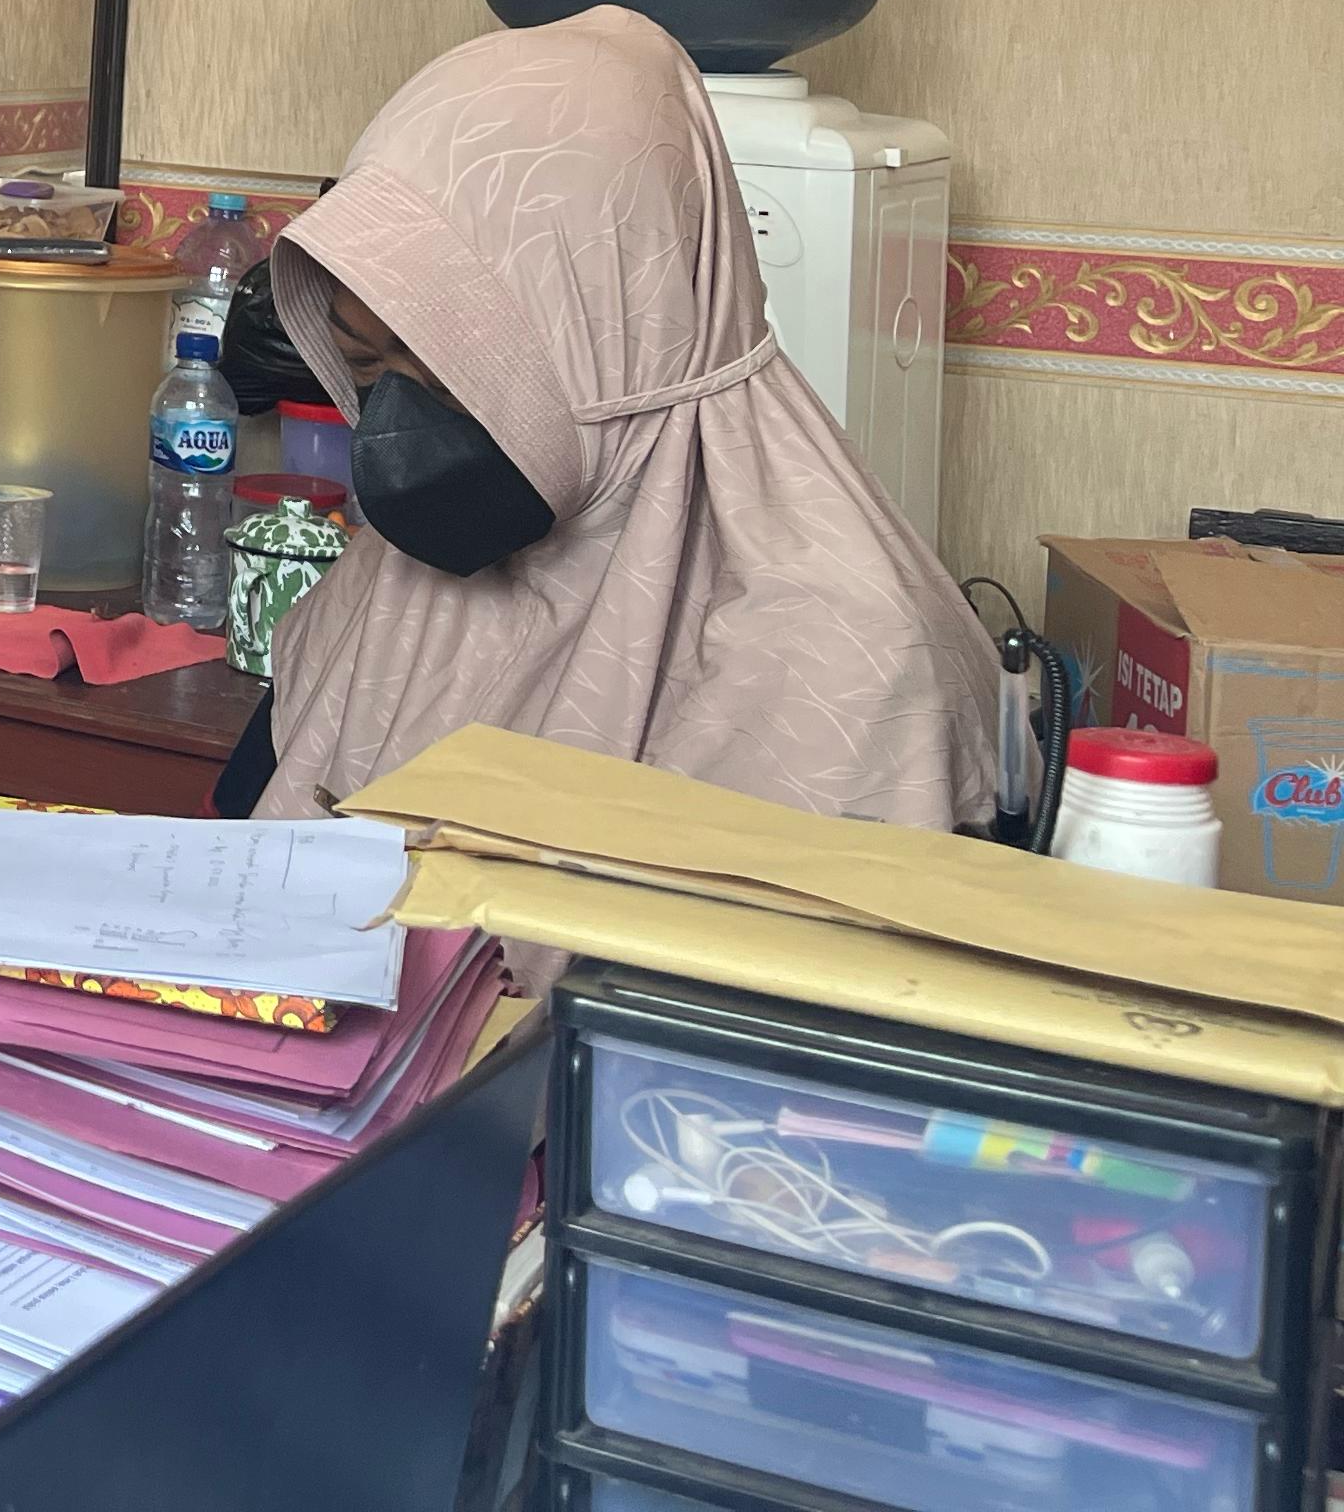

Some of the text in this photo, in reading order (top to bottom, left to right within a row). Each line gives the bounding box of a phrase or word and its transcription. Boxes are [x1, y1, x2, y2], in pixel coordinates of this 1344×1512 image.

[177, 429, 230, 452] AQUA
[1118, 650, 1183, 718] ISI TETAP
[1265, 772, 1341, 807] Club
